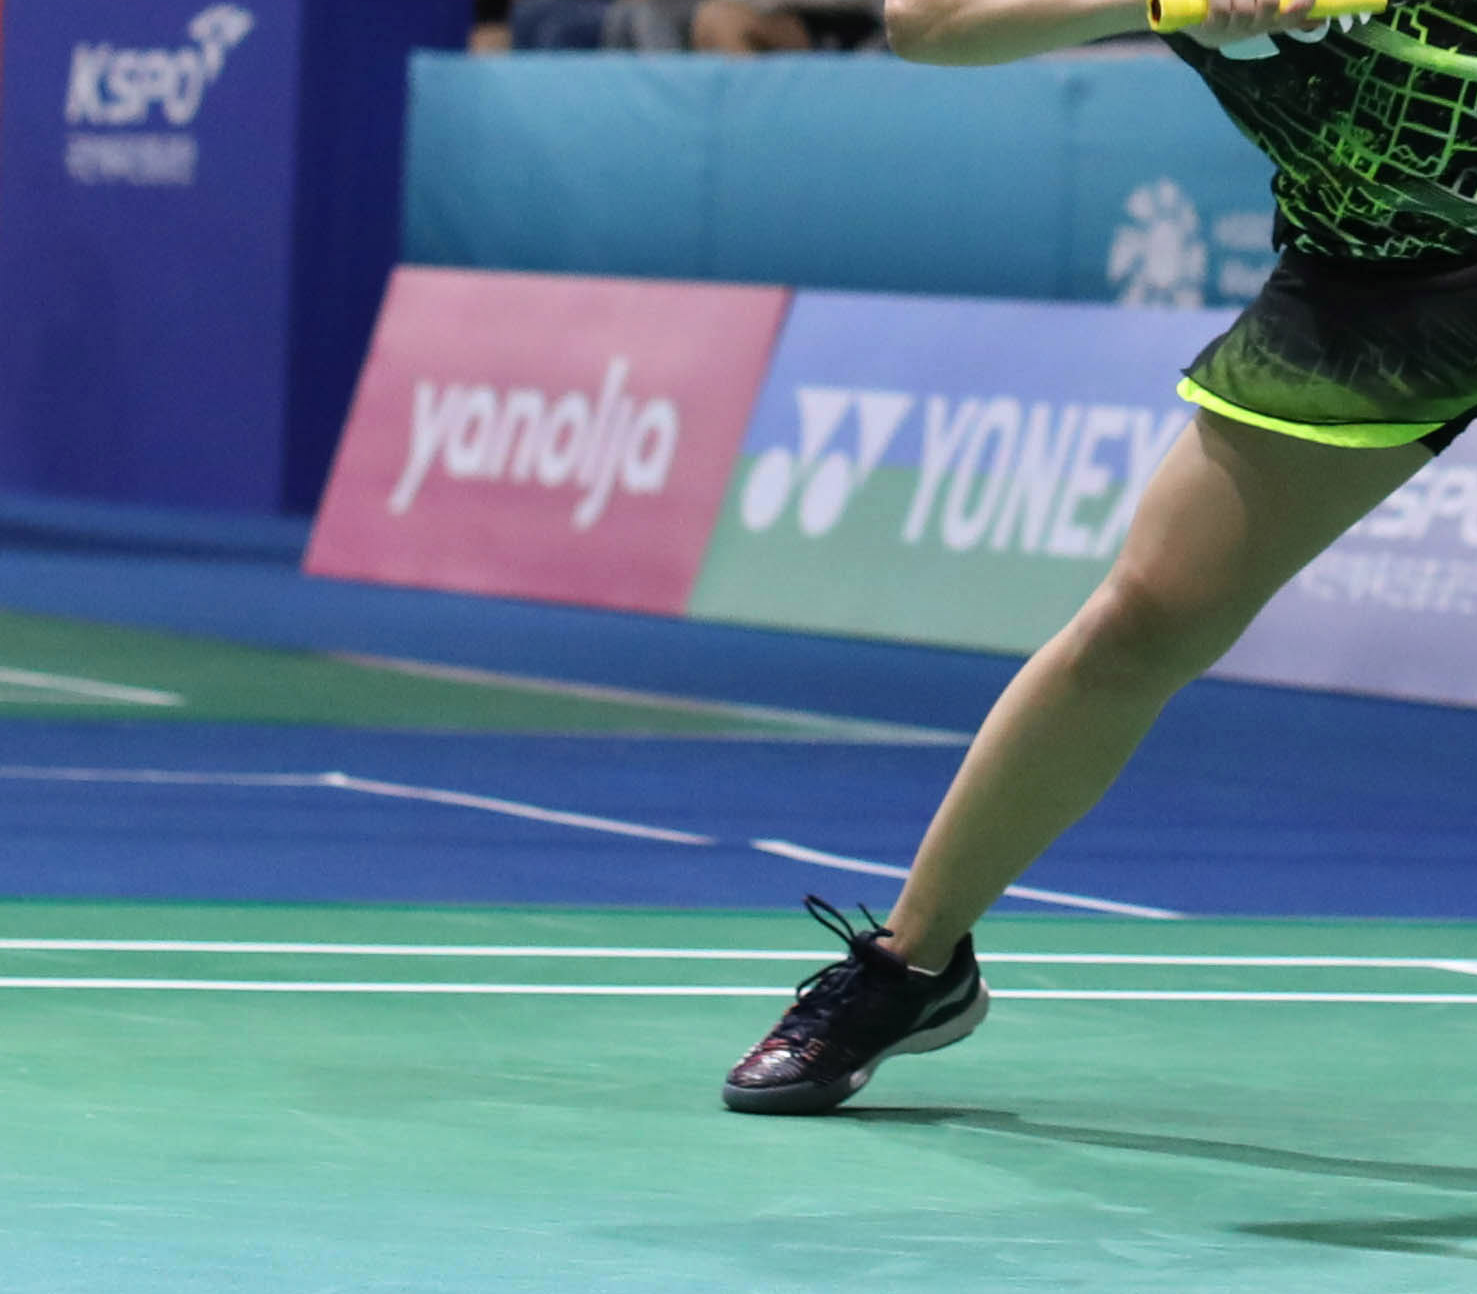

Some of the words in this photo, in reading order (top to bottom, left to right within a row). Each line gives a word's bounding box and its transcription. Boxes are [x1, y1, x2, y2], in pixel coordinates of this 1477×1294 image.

[66, 42, 205, 125] KSPO
[389, 356, 679, 528] yanolja
[902, 396, 1192, 555] YONEX
